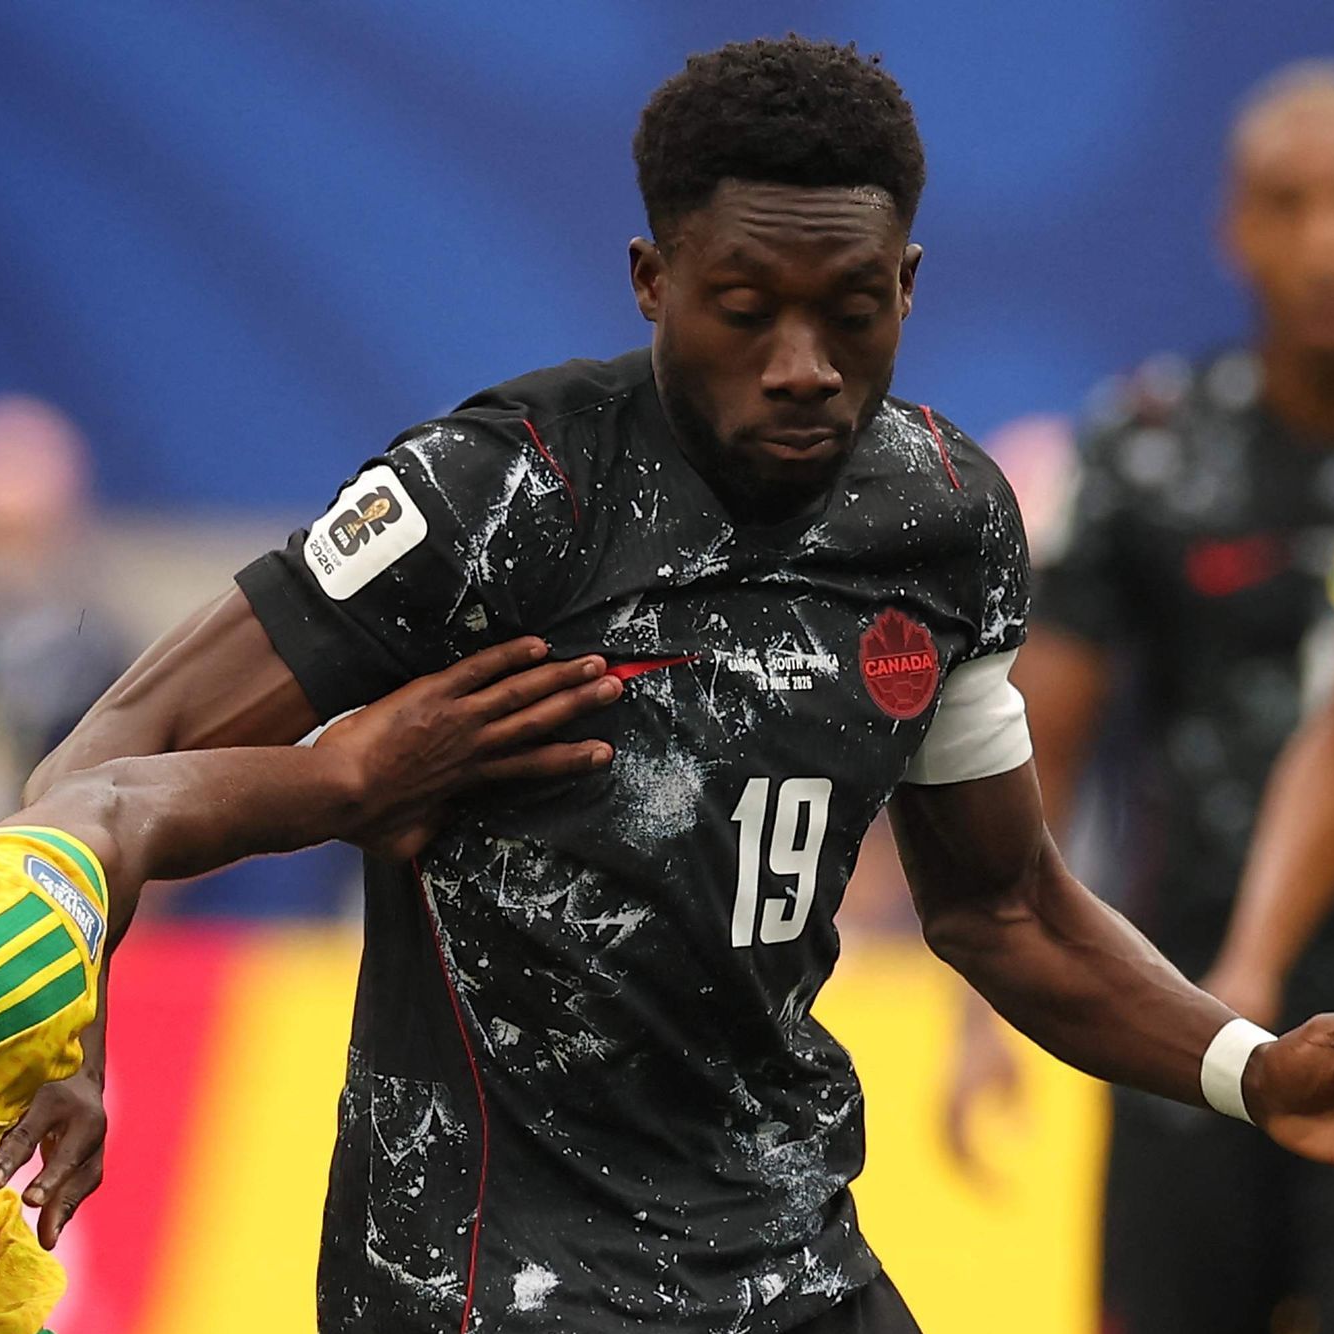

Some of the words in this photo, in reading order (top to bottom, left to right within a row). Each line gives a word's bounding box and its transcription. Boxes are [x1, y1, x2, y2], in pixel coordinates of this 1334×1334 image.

[333, 525, 351, 549] FIFA
[309, 539, 335, 576] 2026
[772, 656, 804, 671] SOUTH
[865, 653, 933, 677] CANADA
[792, 676, 813, 690] 2026
[730, 777, 833, 948] 19
